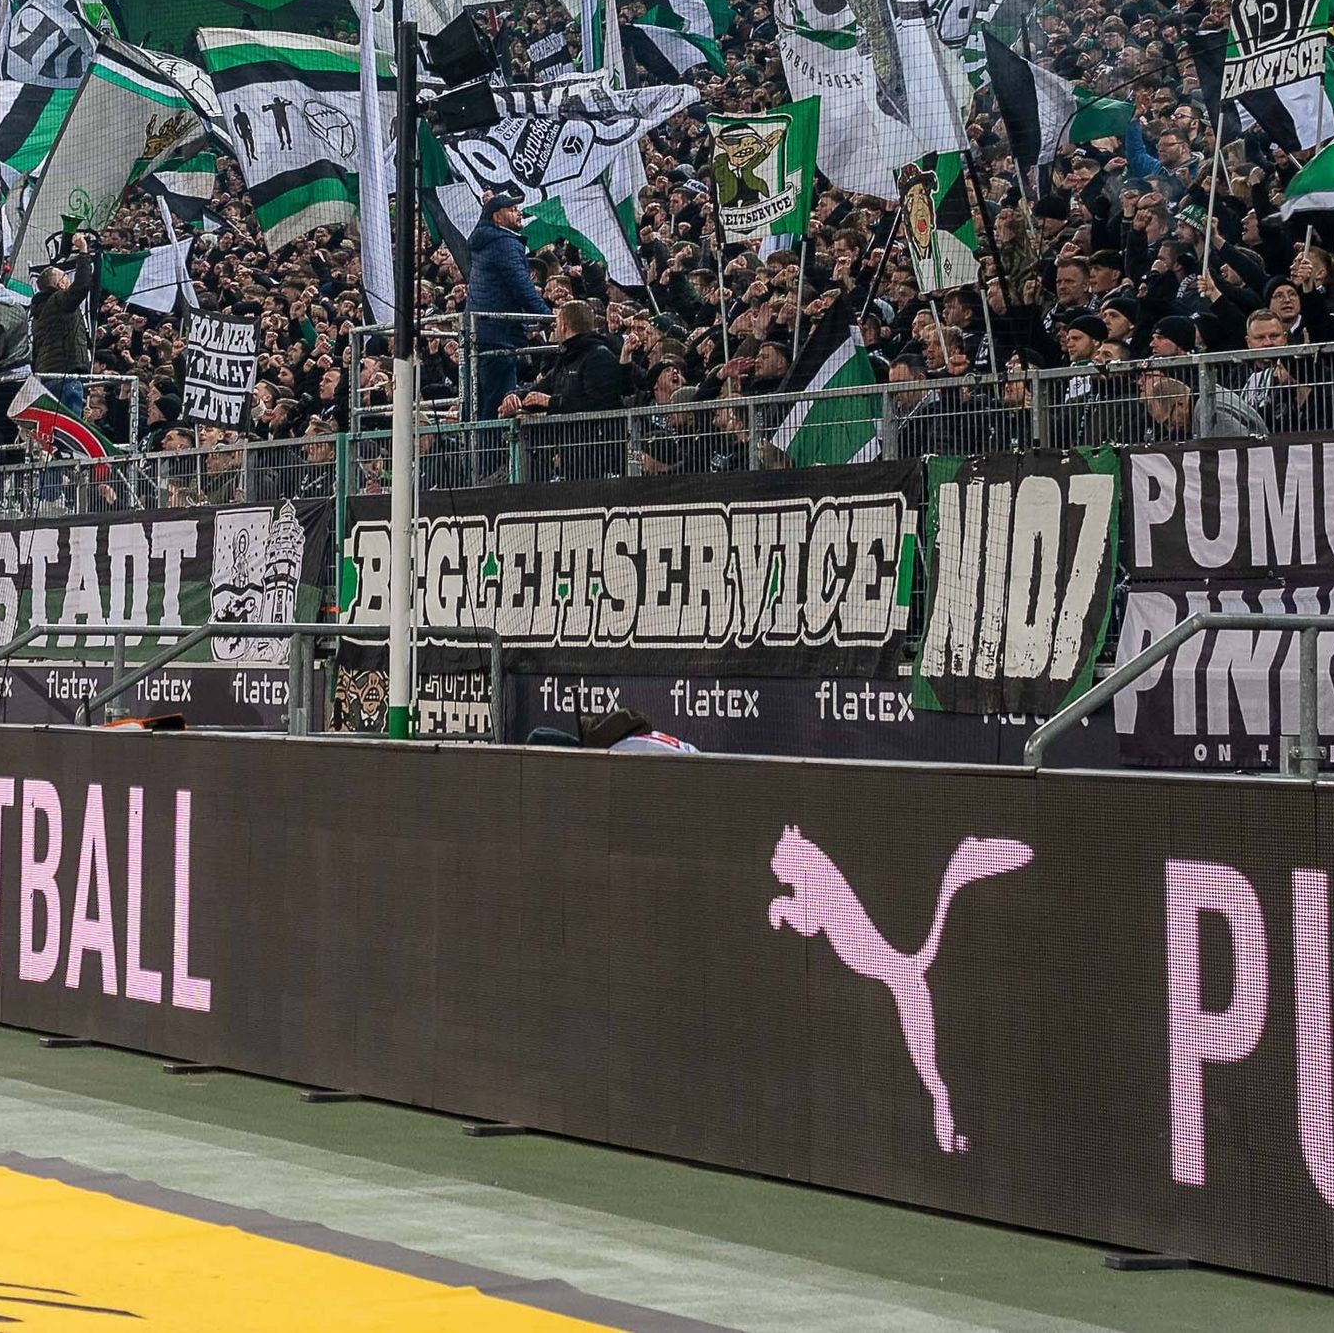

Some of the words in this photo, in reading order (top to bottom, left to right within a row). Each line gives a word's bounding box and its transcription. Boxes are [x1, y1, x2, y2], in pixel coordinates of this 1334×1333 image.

[724, 195, 793, 226] EITSERVICE
[188, 313, 256, 354] KÖLNER
[46, 671, 98, 699] flatex
[539, 677, 620, 715] flatex
[670, 679, 760, 718] flatex
[814, 681, 914, 723] flatex
[1194, 744, 1231, 762] ON
